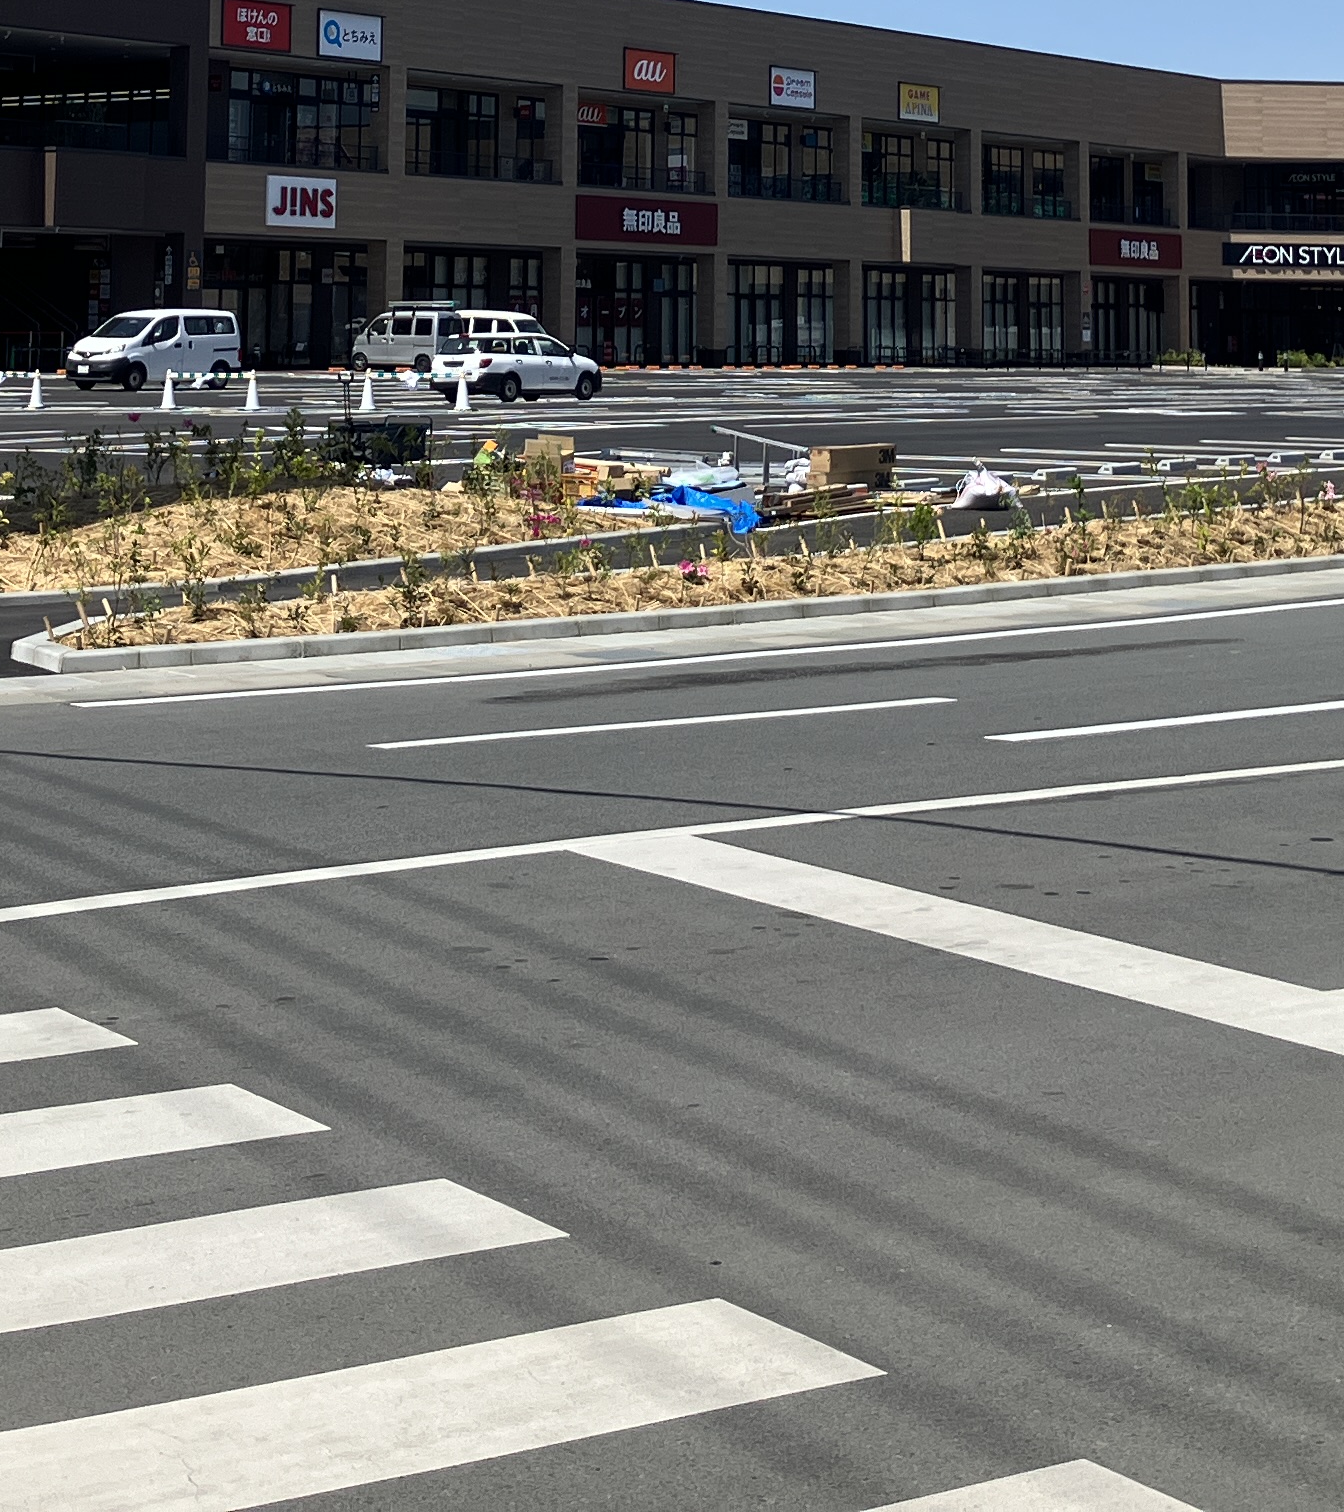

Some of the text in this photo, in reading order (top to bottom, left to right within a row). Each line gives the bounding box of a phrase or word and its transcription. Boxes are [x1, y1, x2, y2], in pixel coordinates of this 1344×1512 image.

[237, 8, 278, 26] ほけんの
[634, 59, 666, 82] au
[907, 88, 930, 101] GAME
[578, 106, 601, 122] au
[622, 207, 681, 235] 無印良品
[1120, 239, 1159, 261] 無印良品
[878, 448, 895, 464] 3M
